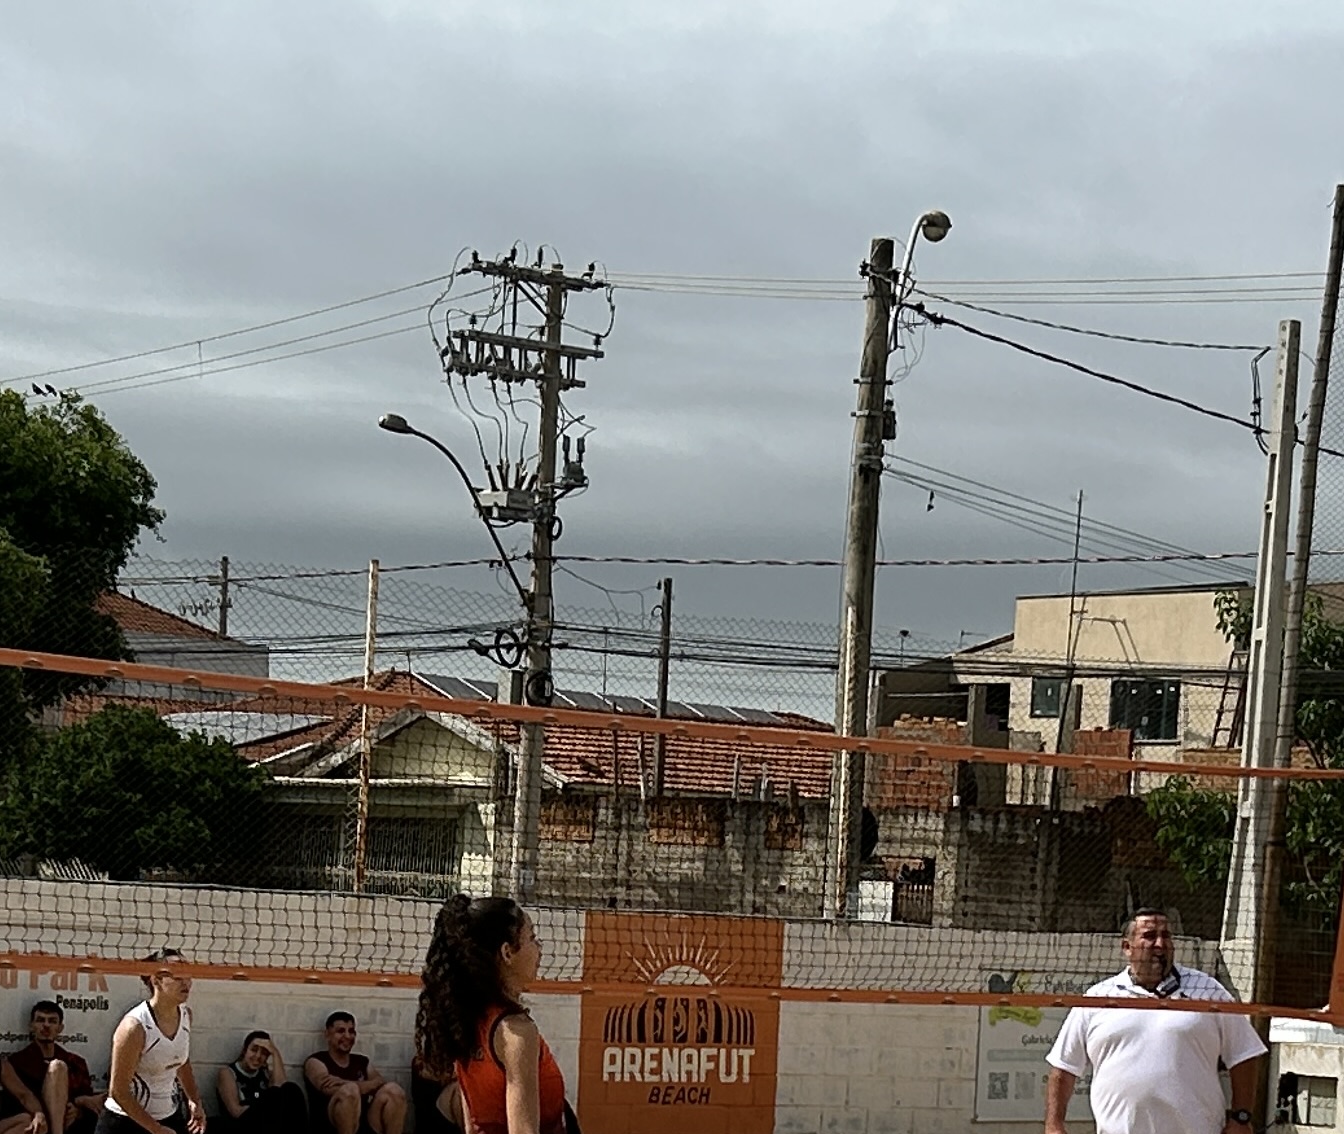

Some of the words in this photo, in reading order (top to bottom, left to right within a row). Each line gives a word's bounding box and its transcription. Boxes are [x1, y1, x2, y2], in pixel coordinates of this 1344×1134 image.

[56, 993, 110, 1013] Penápolis
[602, 1046, 756, 1084] ARENAFUT
[648, 1086, 712, 1105] BEACH
